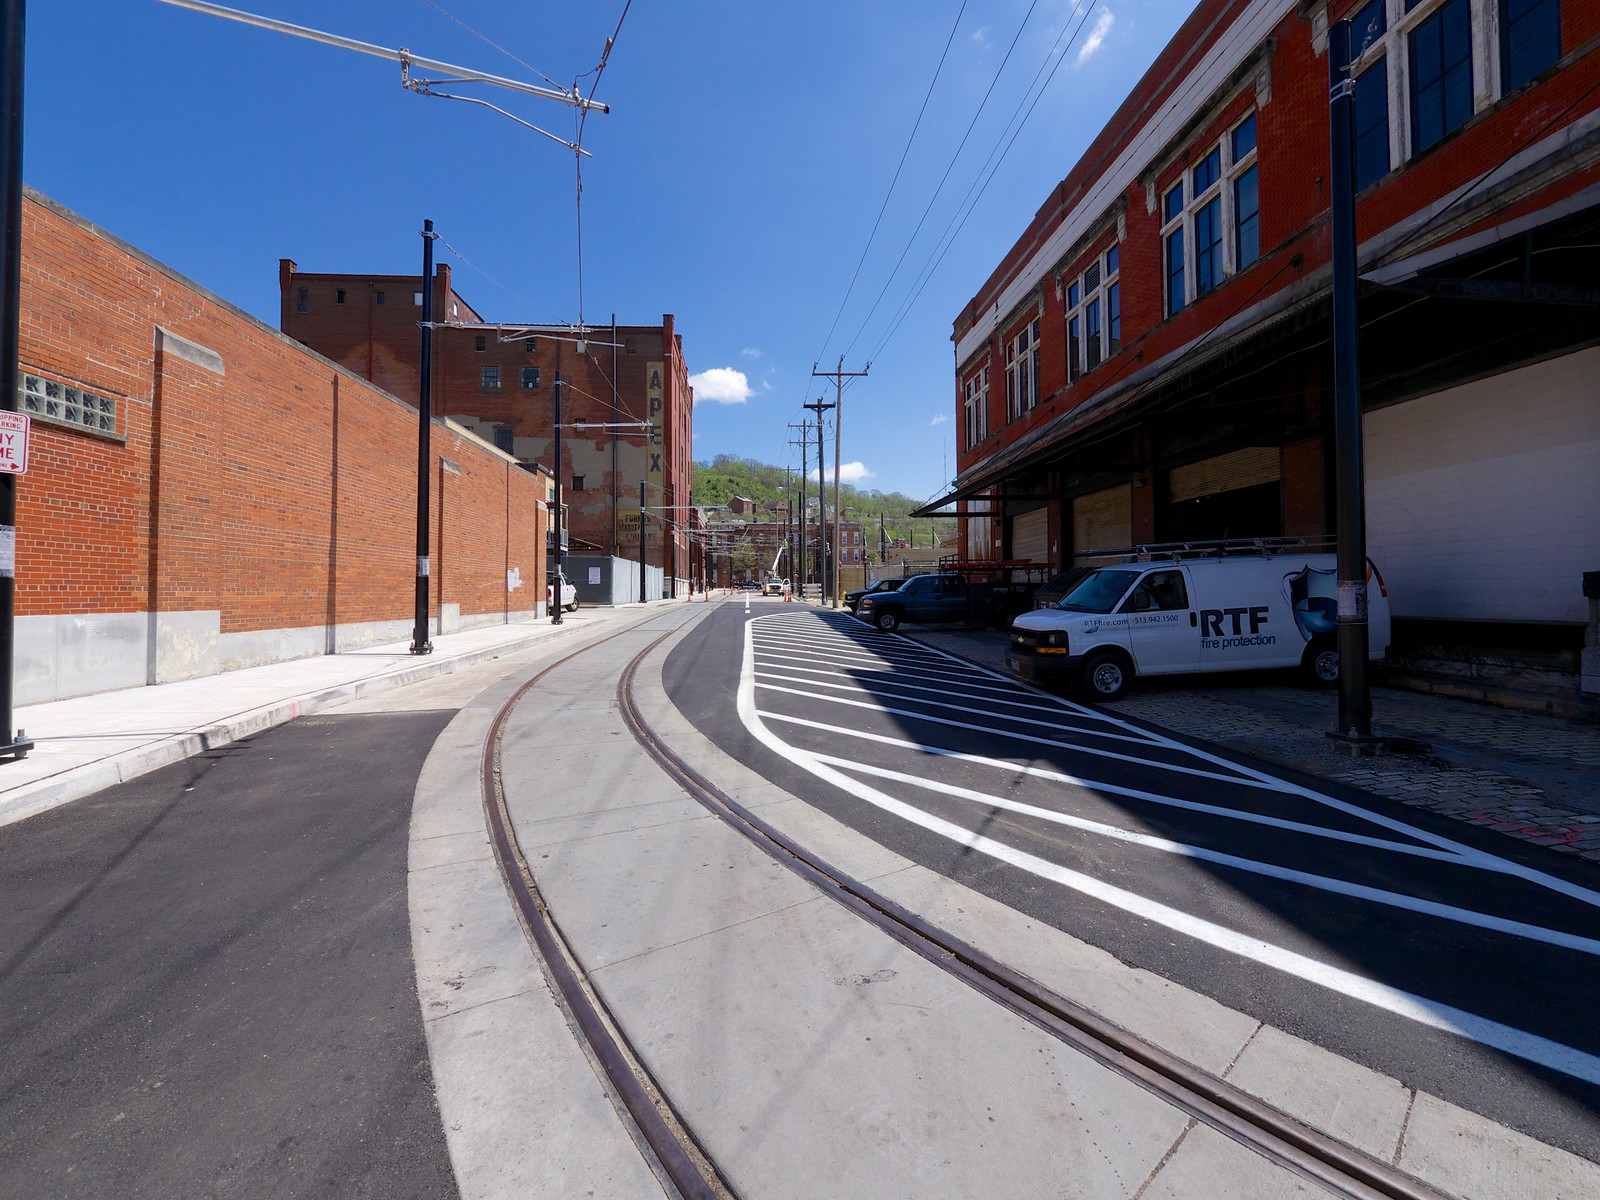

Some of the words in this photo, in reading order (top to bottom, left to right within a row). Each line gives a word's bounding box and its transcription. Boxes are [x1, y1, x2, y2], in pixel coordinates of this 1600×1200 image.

[0, 420, 21, 430] RKING
[650, 370, 662, 472] APEX
[1084, 619, 1129, 628] RTFfire.com
[1134, 614, 1179, 625] 513.942.1500
[1200, 606, 1269, 638] RTF
[1201, 637, 1219, 649] fire
[1222, 634, 1276, 650] protection
